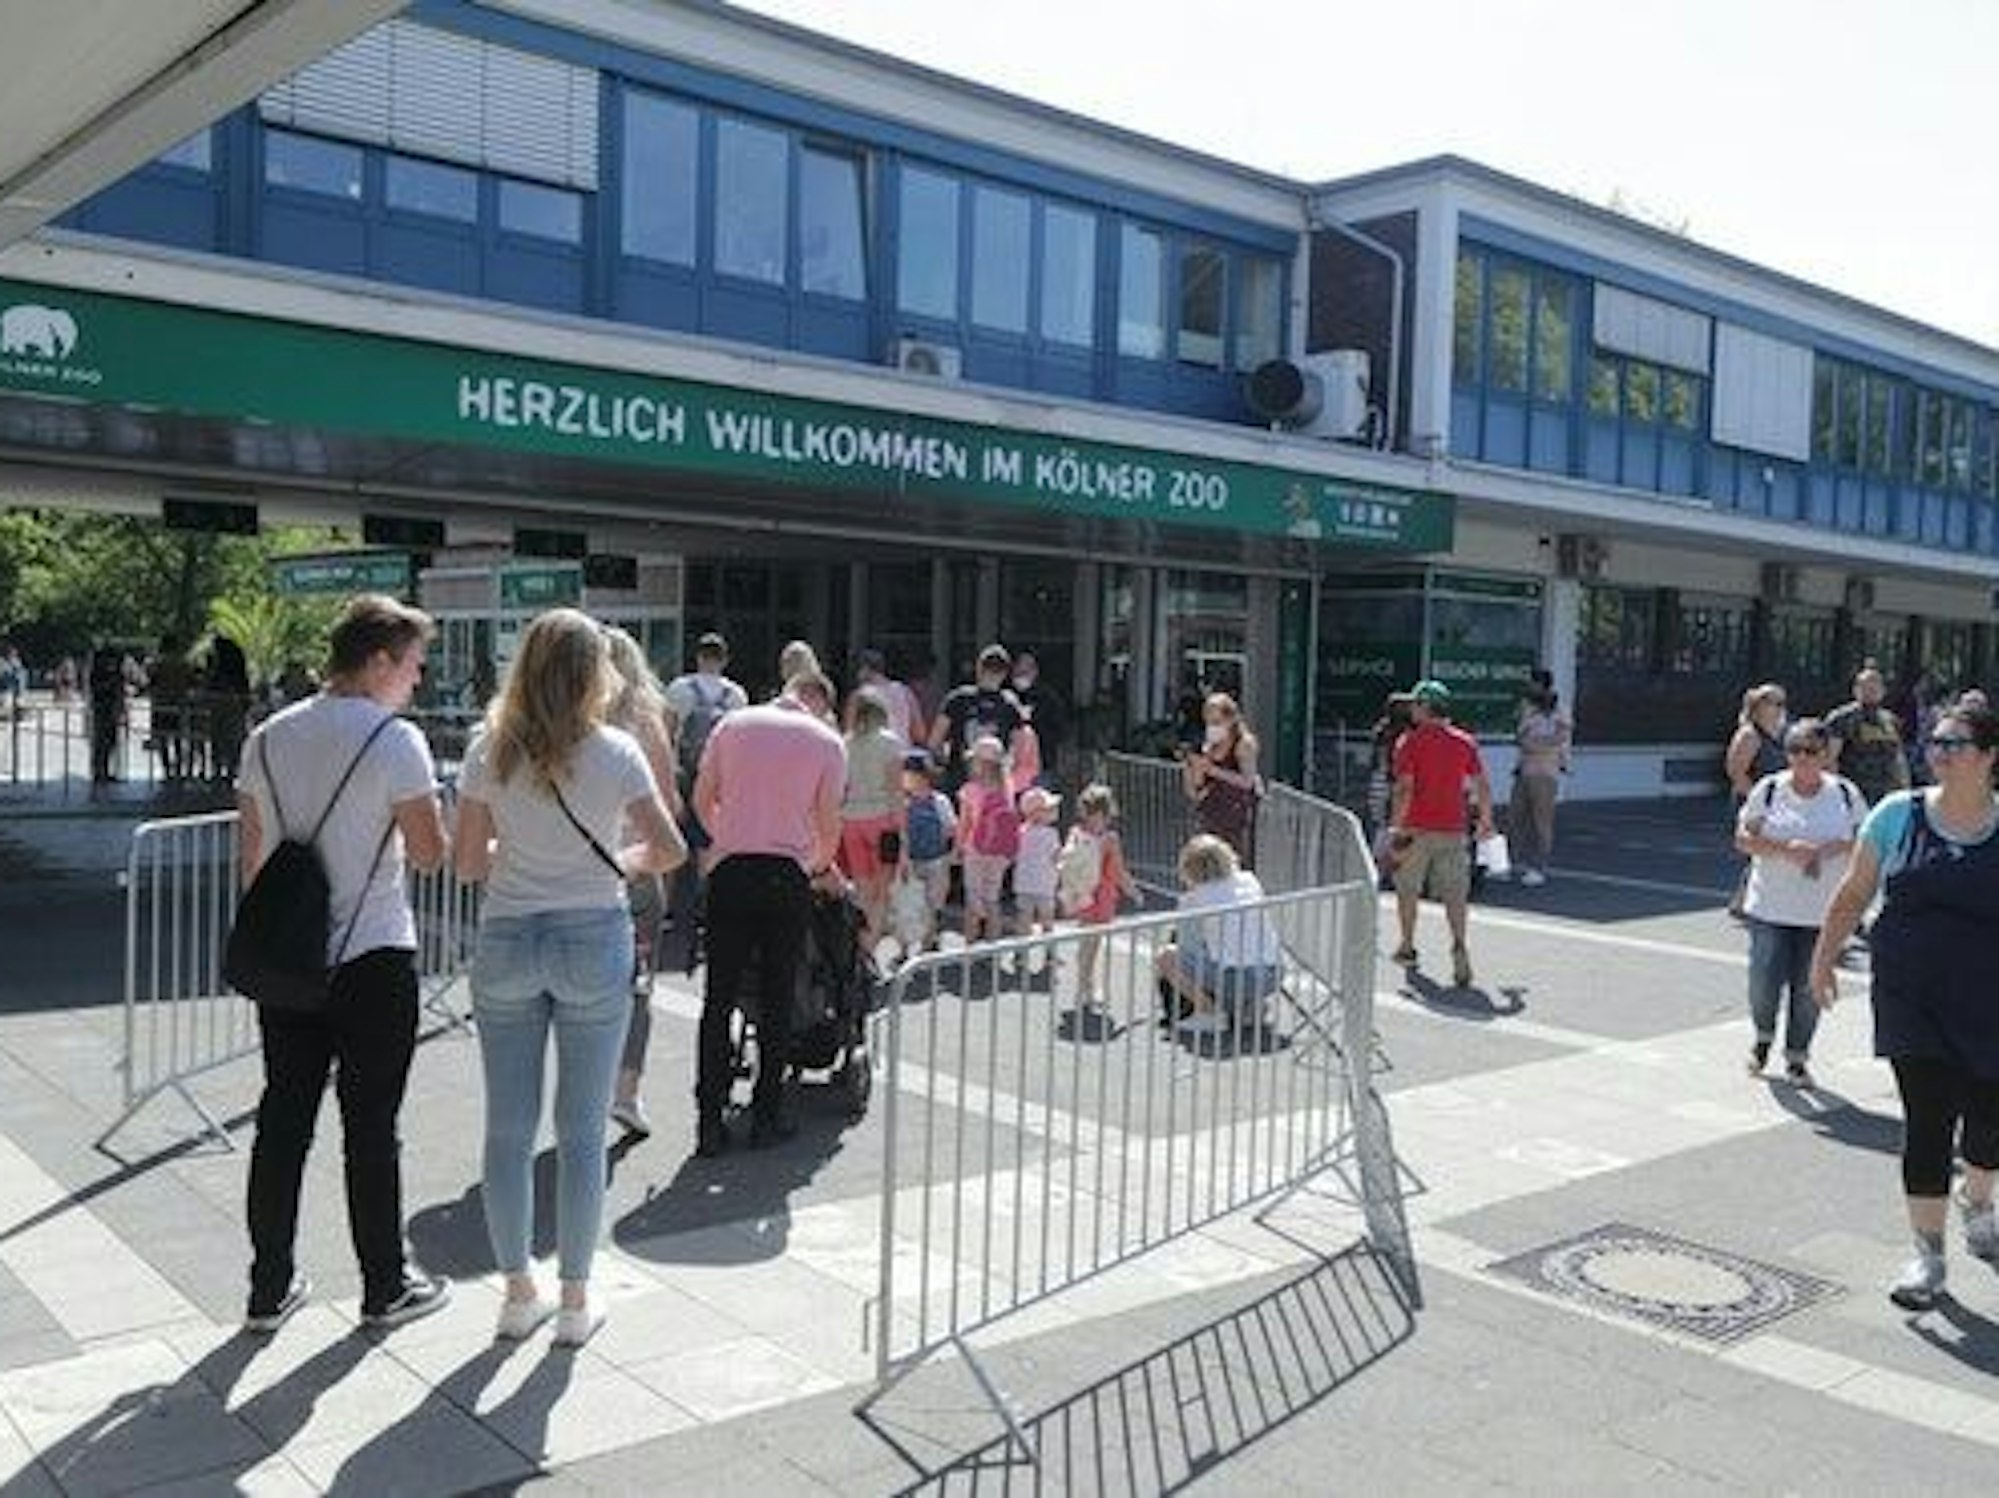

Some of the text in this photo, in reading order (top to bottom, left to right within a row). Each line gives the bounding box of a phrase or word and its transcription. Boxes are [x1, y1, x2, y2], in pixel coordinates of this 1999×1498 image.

[459, 376, 1227, 511] HERZLICH WILLKOMMEN IM KÖLNER ZOO
